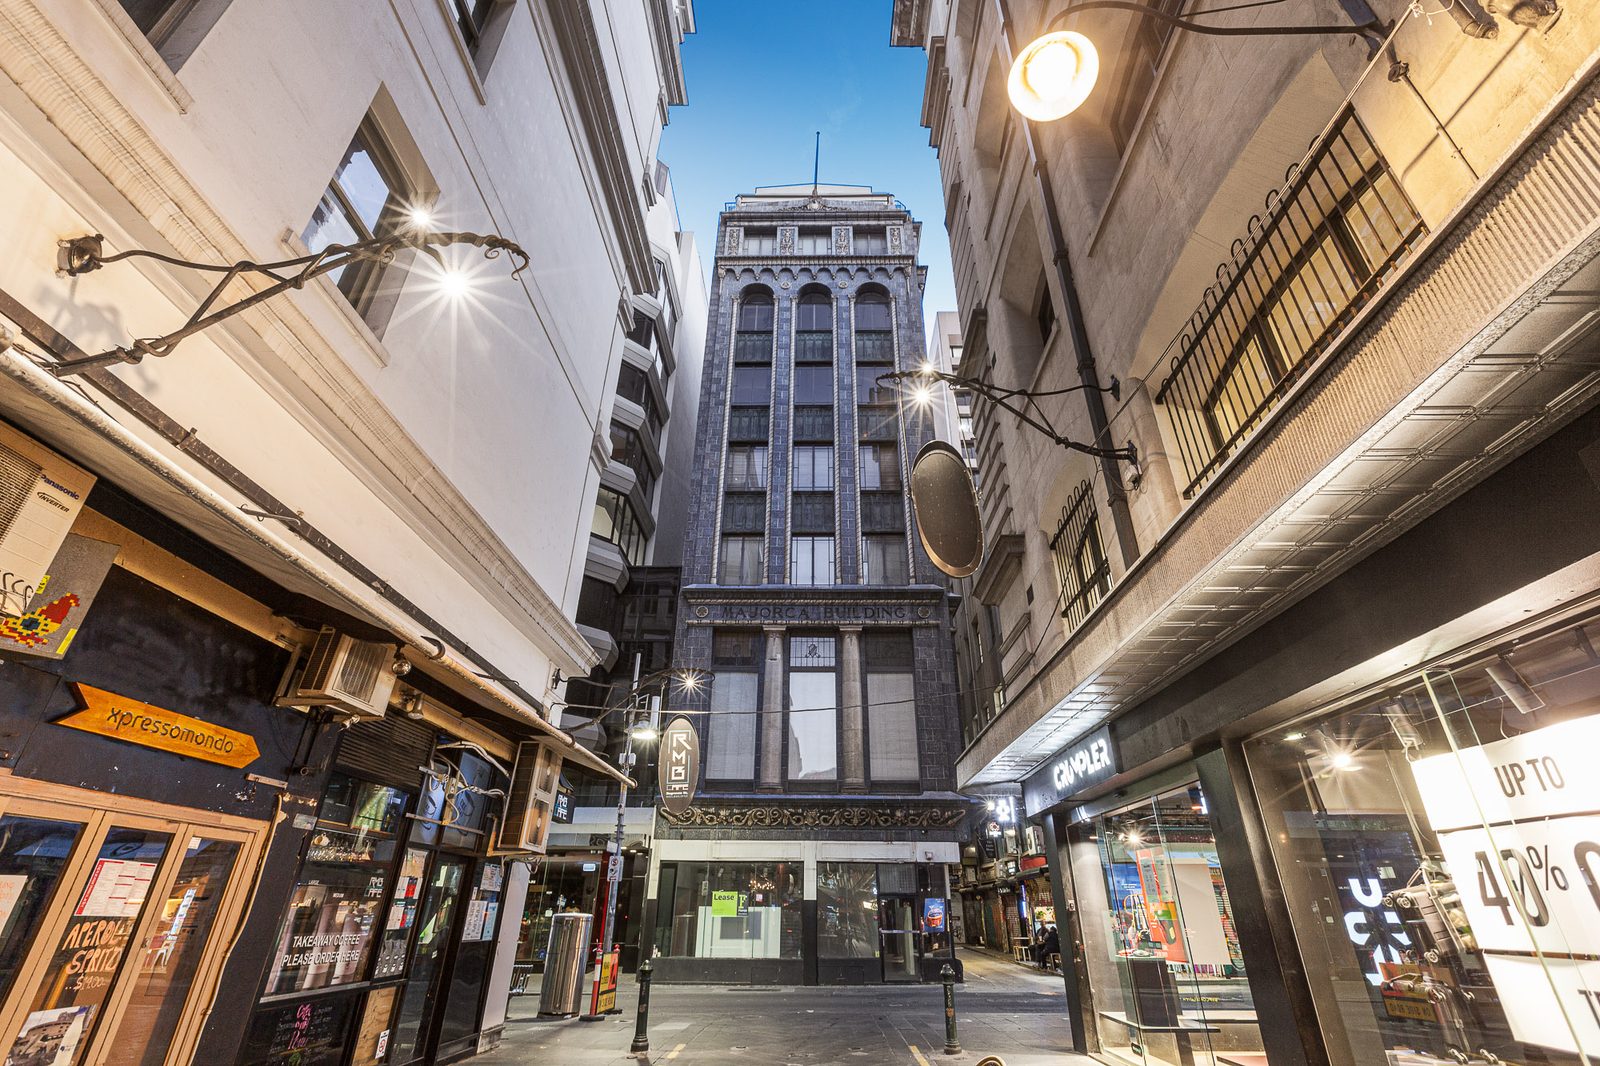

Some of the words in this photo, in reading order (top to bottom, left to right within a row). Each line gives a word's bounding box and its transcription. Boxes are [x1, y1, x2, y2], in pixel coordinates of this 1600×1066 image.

[39, 494, 70, 512] INVERTER
[721, 606, 809, 618] MAJORCA
[823, 606, 905, 618] BUILDING
[106, 707, 234, 753] xpressomondo
[1494, 762, 1526, 798] UP
[1525, 756, 1565, 792] TO
[713, 893, 735, 901] Lease
[1474, 845, 1569, 928] 40%
[61, 920, 122, 950] APEROL
[292, 935, 334, 948] TAKEAWAY
[334, 934, 361, 946] COFFEE
[66, 947, 122, 975] SPRITZ
[281, 952, 314, 967] PLEASE
[314, 951, 340, 964] ORDER
[341, 950, 360, 962] HERE
